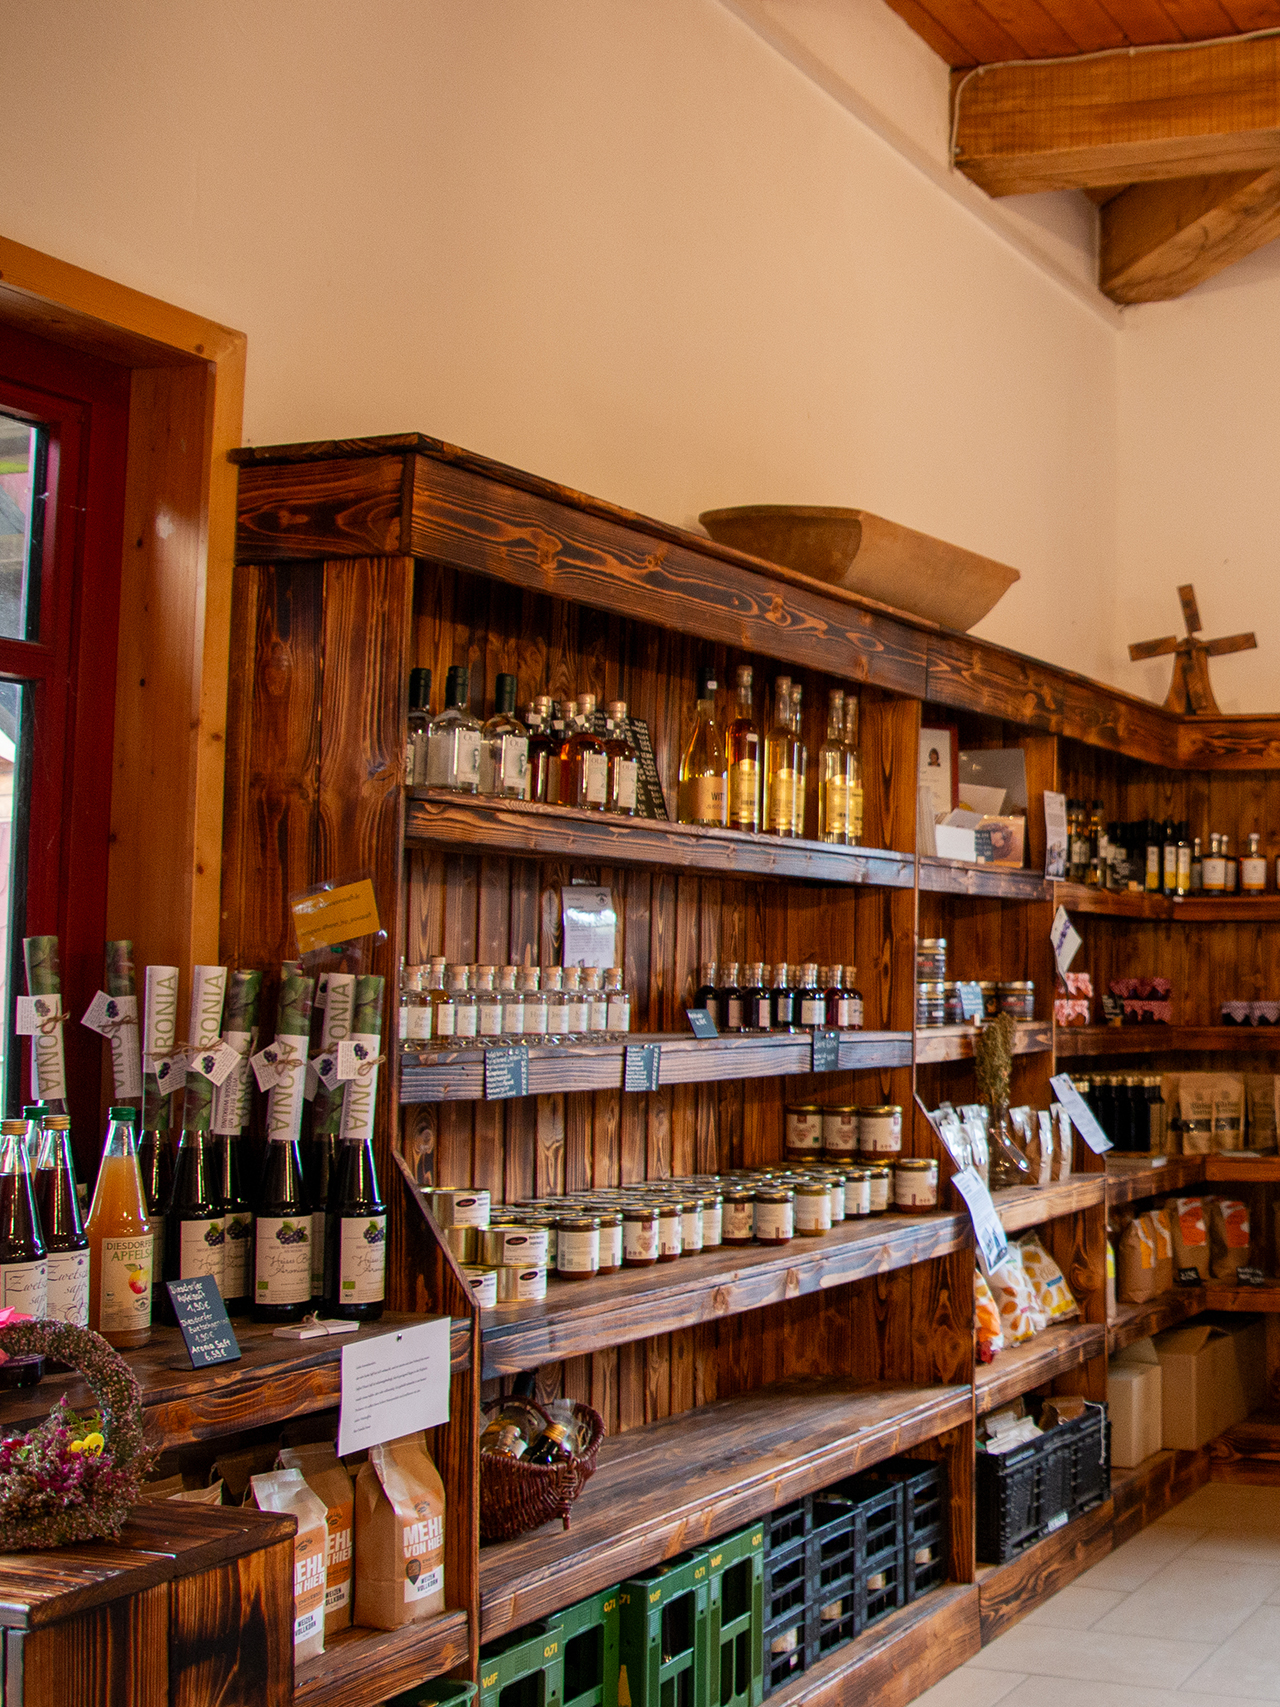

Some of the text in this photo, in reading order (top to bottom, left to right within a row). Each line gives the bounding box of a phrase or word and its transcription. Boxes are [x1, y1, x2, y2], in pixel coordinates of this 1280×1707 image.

[154, 975, 176, 1050] RONIA
[200, 973, 223, 1049] RONIA
[271, 1041, 298, 1132] AONIA
[106, 1240, 153, 1250] DIESDORFE
[327, 1528, 353, 1555] EHL
[403, 1515, 444, 1547] MEHL
[404, 1541, 427, 1558] VON
[295, 1553, 325, 1584] EHL
[304, 1572, 325, 1592] HIER
[325, 1593, 345, 1607] OLLKORN
[482, 1672, 498, 1689] VdF
